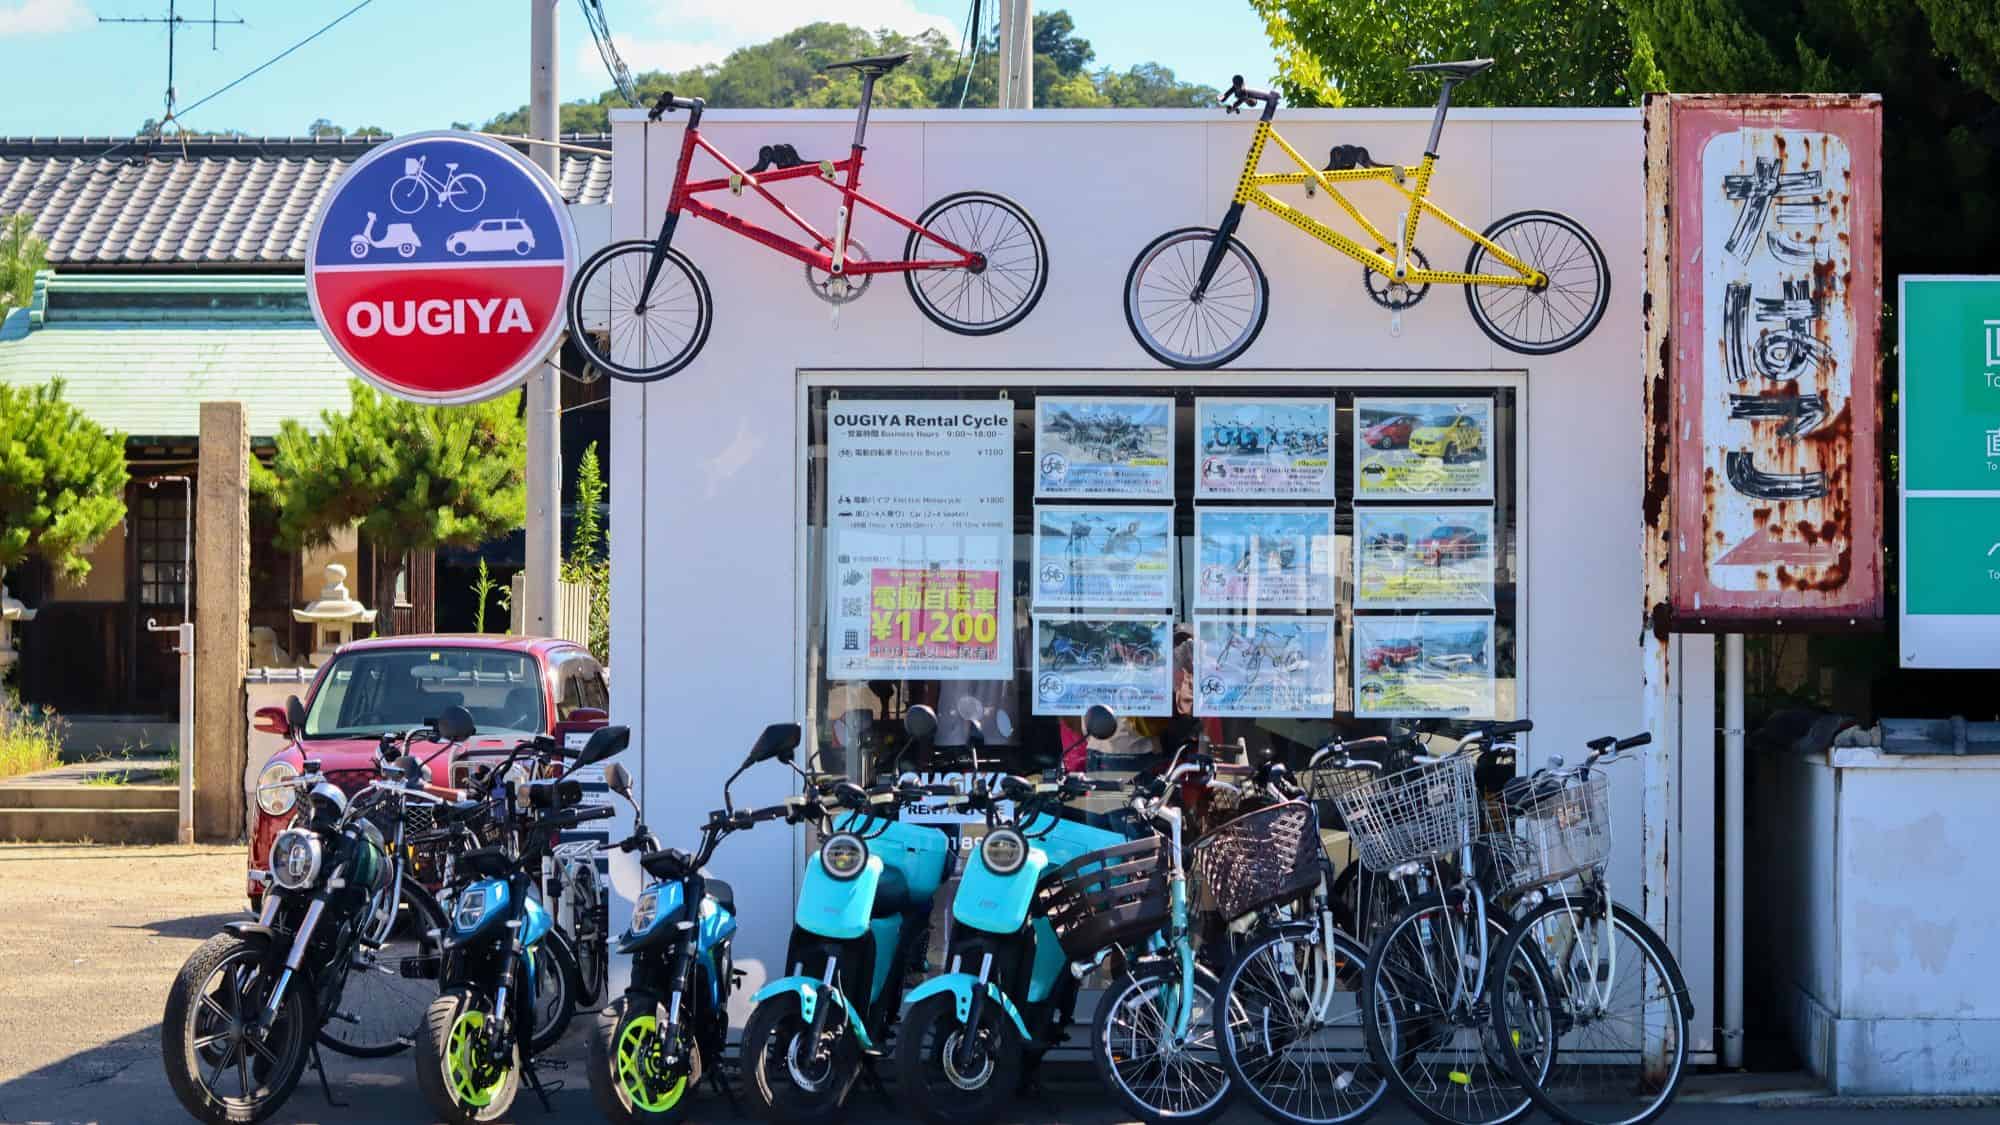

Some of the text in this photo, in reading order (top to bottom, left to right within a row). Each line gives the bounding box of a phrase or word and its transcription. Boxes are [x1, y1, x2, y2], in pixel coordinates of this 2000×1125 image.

[346, 297, 534, 338] OUGIYA
[833, 413, 1009, 430] OUGIYA Rental Cycle
[873, 584, 997, 611] 電動自転車
[871, 611, 997, 646] ¥1,200
